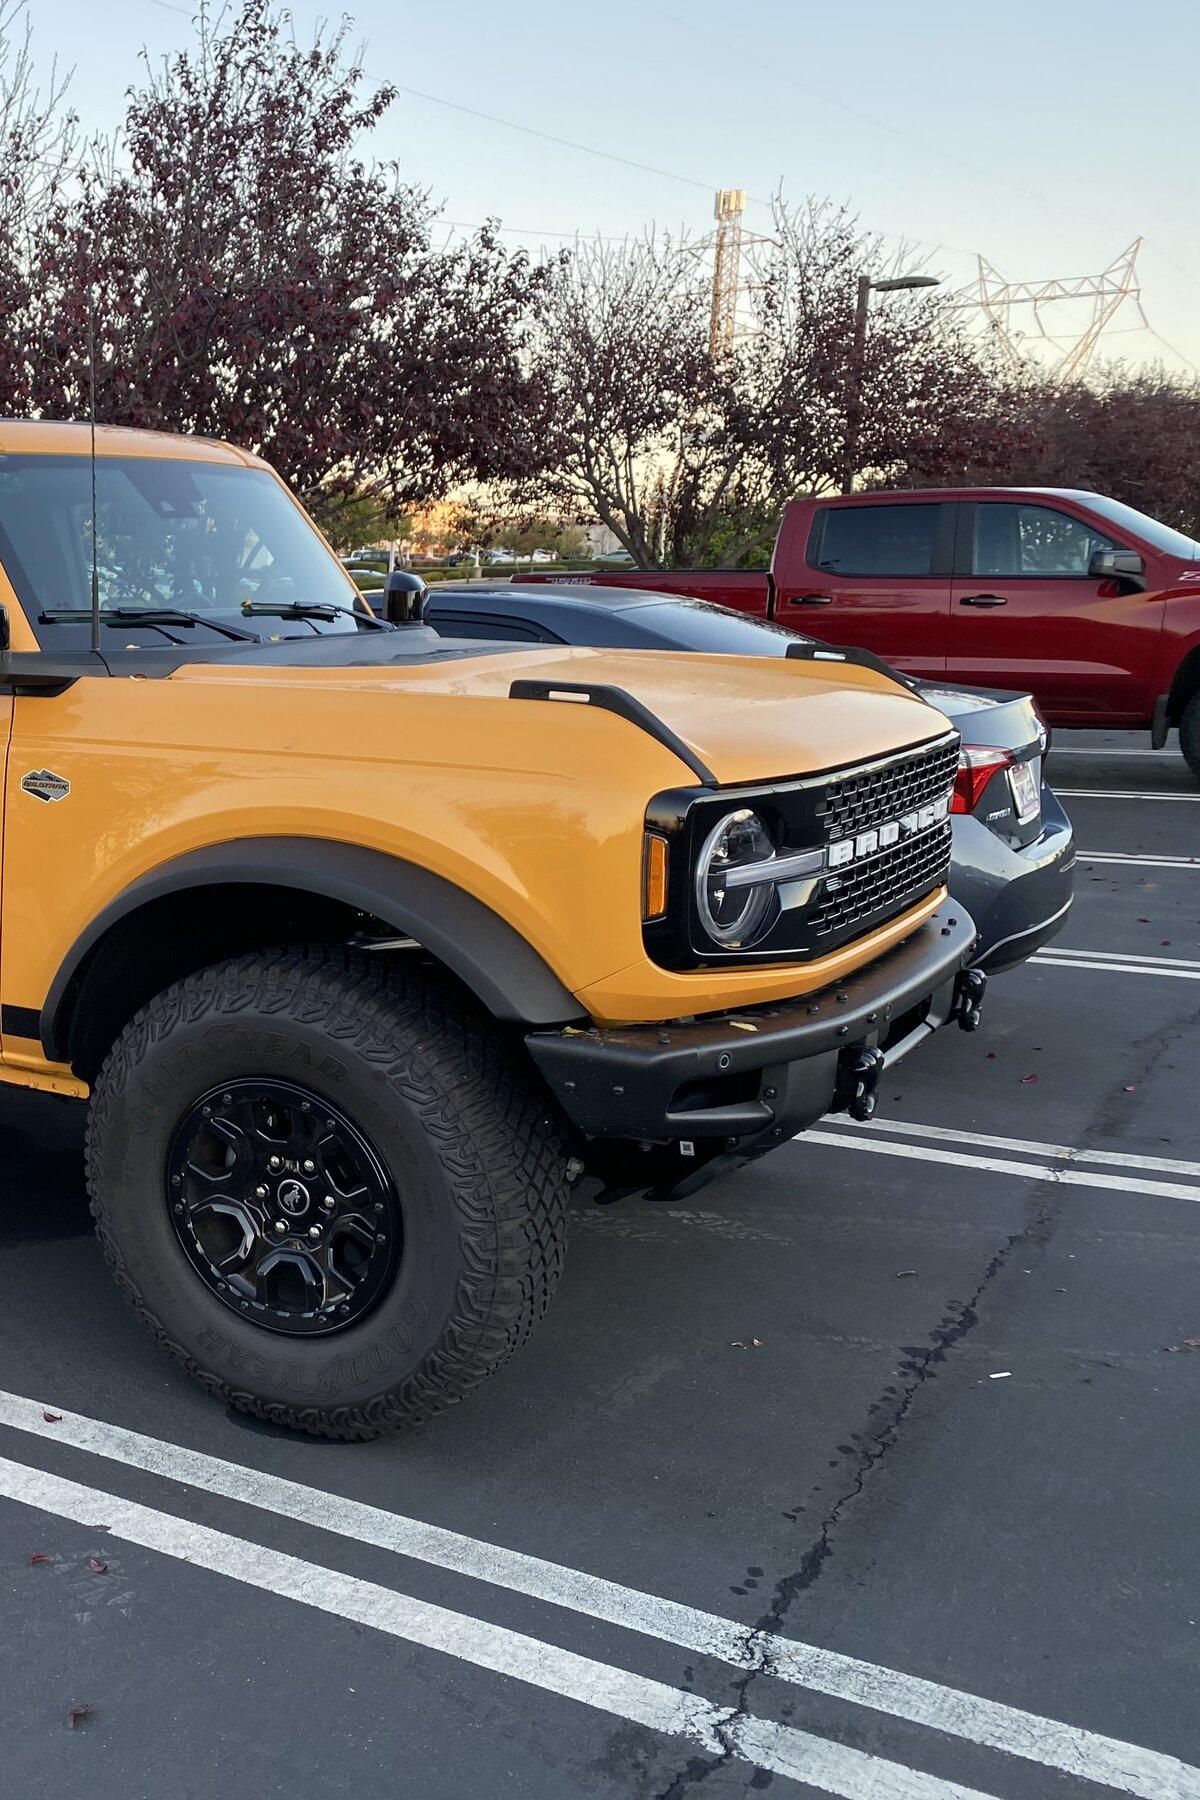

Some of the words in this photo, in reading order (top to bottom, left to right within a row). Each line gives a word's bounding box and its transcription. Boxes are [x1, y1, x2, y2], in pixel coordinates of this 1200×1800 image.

[23, 780, 68, 791] WILDTRAK
[829, 798, 949, 867] BRONCO
[133, 1022, 349, 1132] GOODYEAR
[194, 1296, 428, 1399] GOODYEAR
